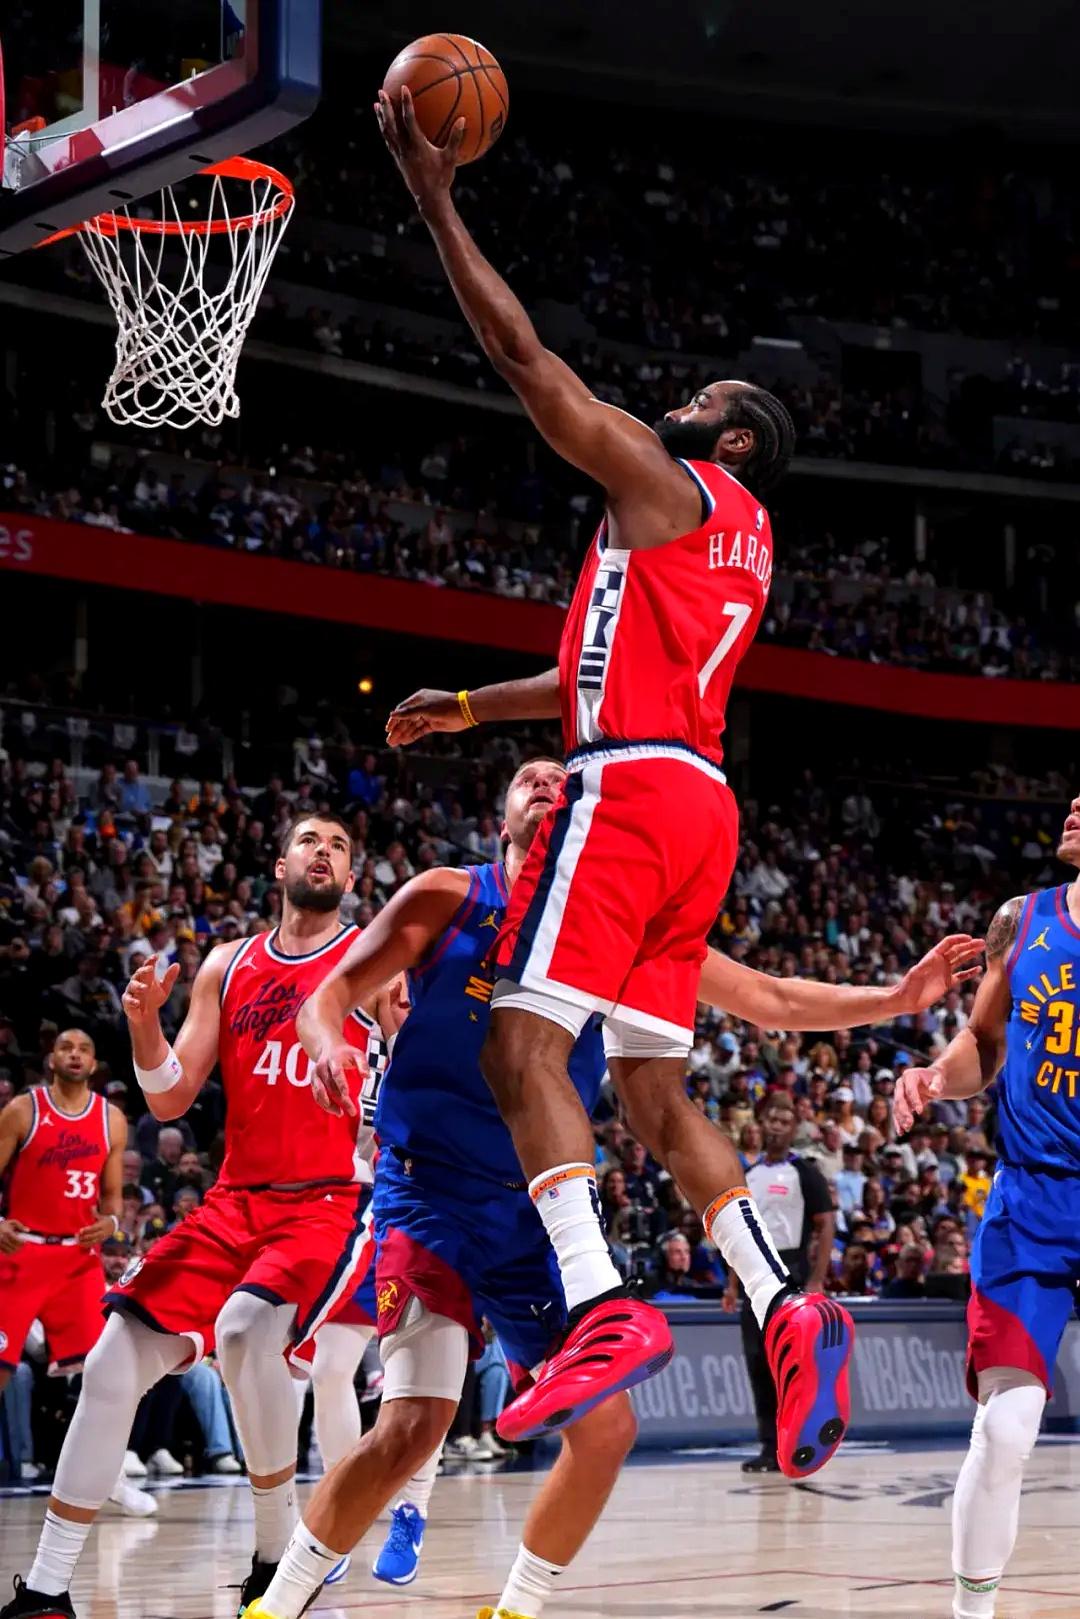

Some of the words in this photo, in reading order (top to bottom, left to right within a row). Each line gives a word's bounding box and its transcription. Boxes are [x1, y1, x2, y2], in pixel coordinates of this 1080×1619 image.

[697, 601, 753, 700] 7
[253, 976, 298, 1007] Los
[1020, 963, 1076, 1026] MILE
[1045, 1001, 1080, 1058] 3
[252, 1039, 318, 1088] 40
[1036, 1060, 1080, 1098] CIT
[63, 1169, 97, 1200] 33
[854, 1336, 971, 1411] NBAStor
